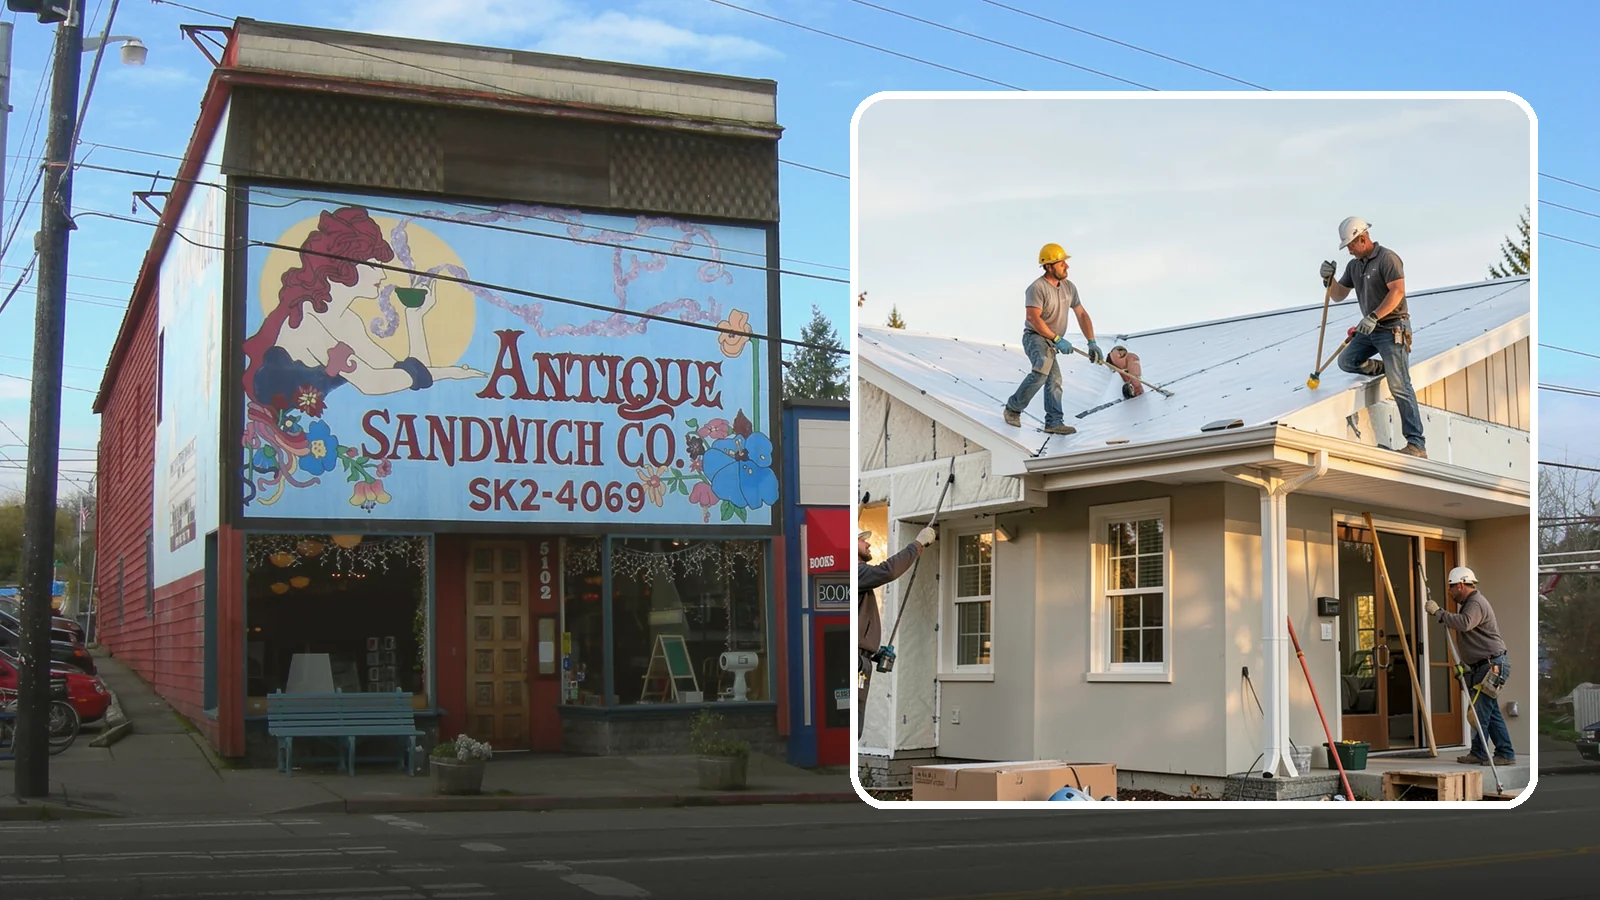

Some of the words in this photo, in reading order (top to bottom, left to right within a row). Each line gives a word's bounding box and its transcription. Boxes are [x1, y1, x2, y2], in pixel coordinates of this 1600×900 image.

[475, 329, 723, 421] ANTIQUE
[361, 409, 604, 467] SANDWICH
[618, 422, 684, 468] CO.
[469, 477, 646, 513] SK2-4069
[540, 542, 552, 600] 5102
[809, 555, 835, 569] BOOKS
